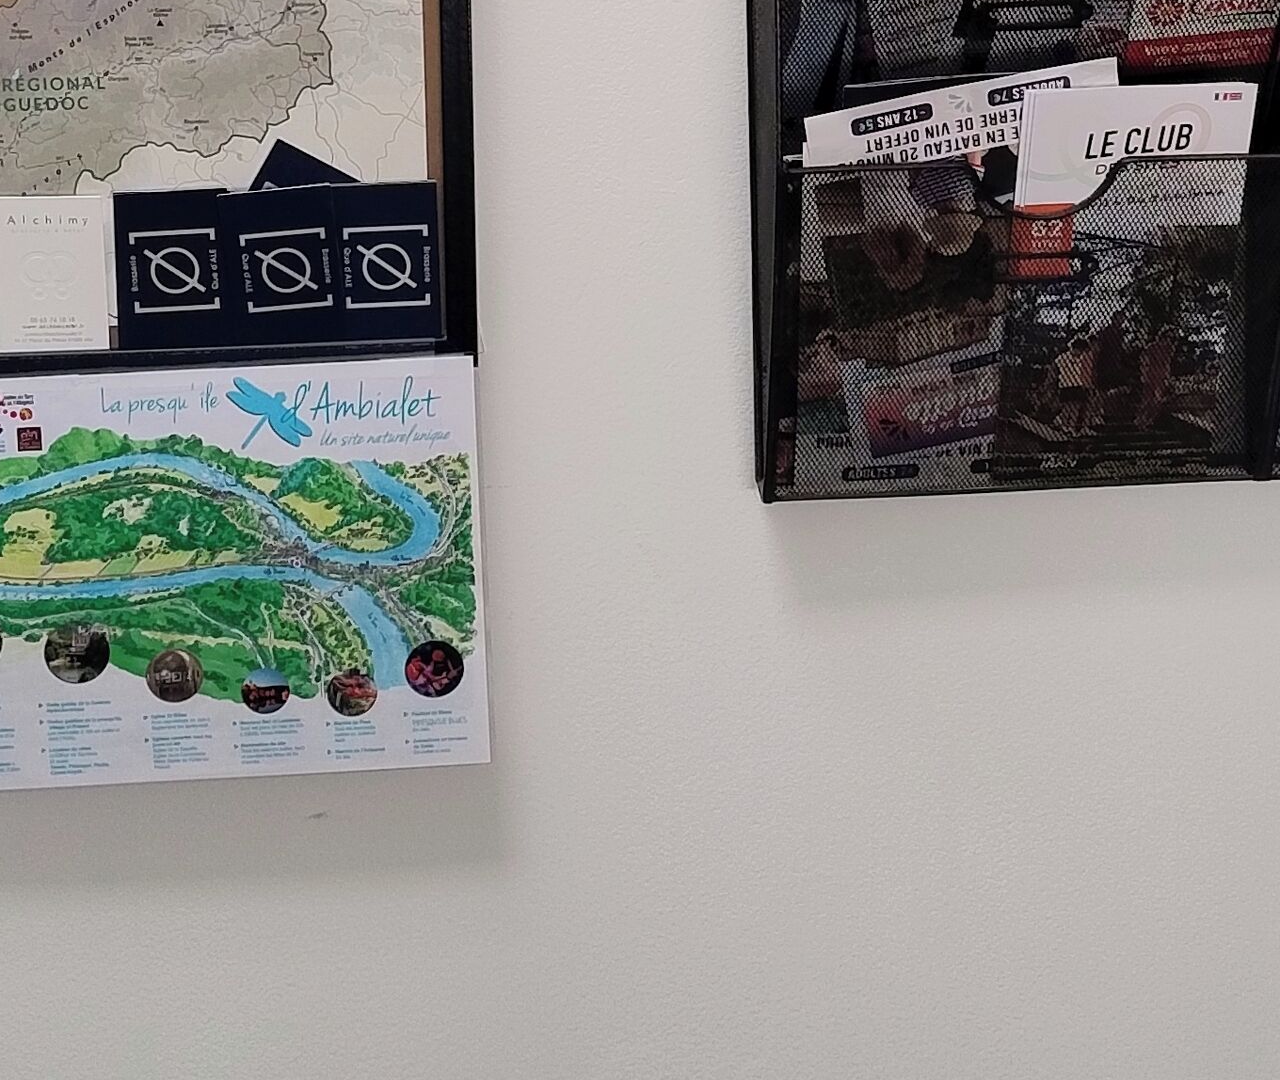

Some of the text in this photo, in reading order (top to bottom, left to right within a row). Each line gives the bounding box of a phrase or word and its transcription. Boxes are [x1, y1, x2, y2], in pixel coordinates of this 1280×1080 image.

[28, 48, 64, 73] Monts
[69, 36, 82, 48] de
[2, 72, 106, 91] RÉGIONAL
[876, 111, 901, 128] ANS
[904, 106, 926, 119] -12
[865, 109, 1017, 154] ERRE DE VIN OFFERT
[986, 129, 1005, 144] EN
[1085, 123, 1193, 159] LE CLUB
[900, 144, 919, 160] 20
[923, 132, 981, 158] BATEAU
[7, 214, 90, 227] Alchimy
[241, 253, 250, 269] Que
[321, 248, 331, 284] Brasserie
[343, 247, 351, 262] Que
[423, 245, 431, 283] Brasserie
[131, 254, 139, 292] Brasserie
[211, 273, 219, 290] Que
[101, 387, 122, 414] La
[281, 376, 442, 427] d'Ambialet
[320, 424, 450, 449] Un site naturel unique
